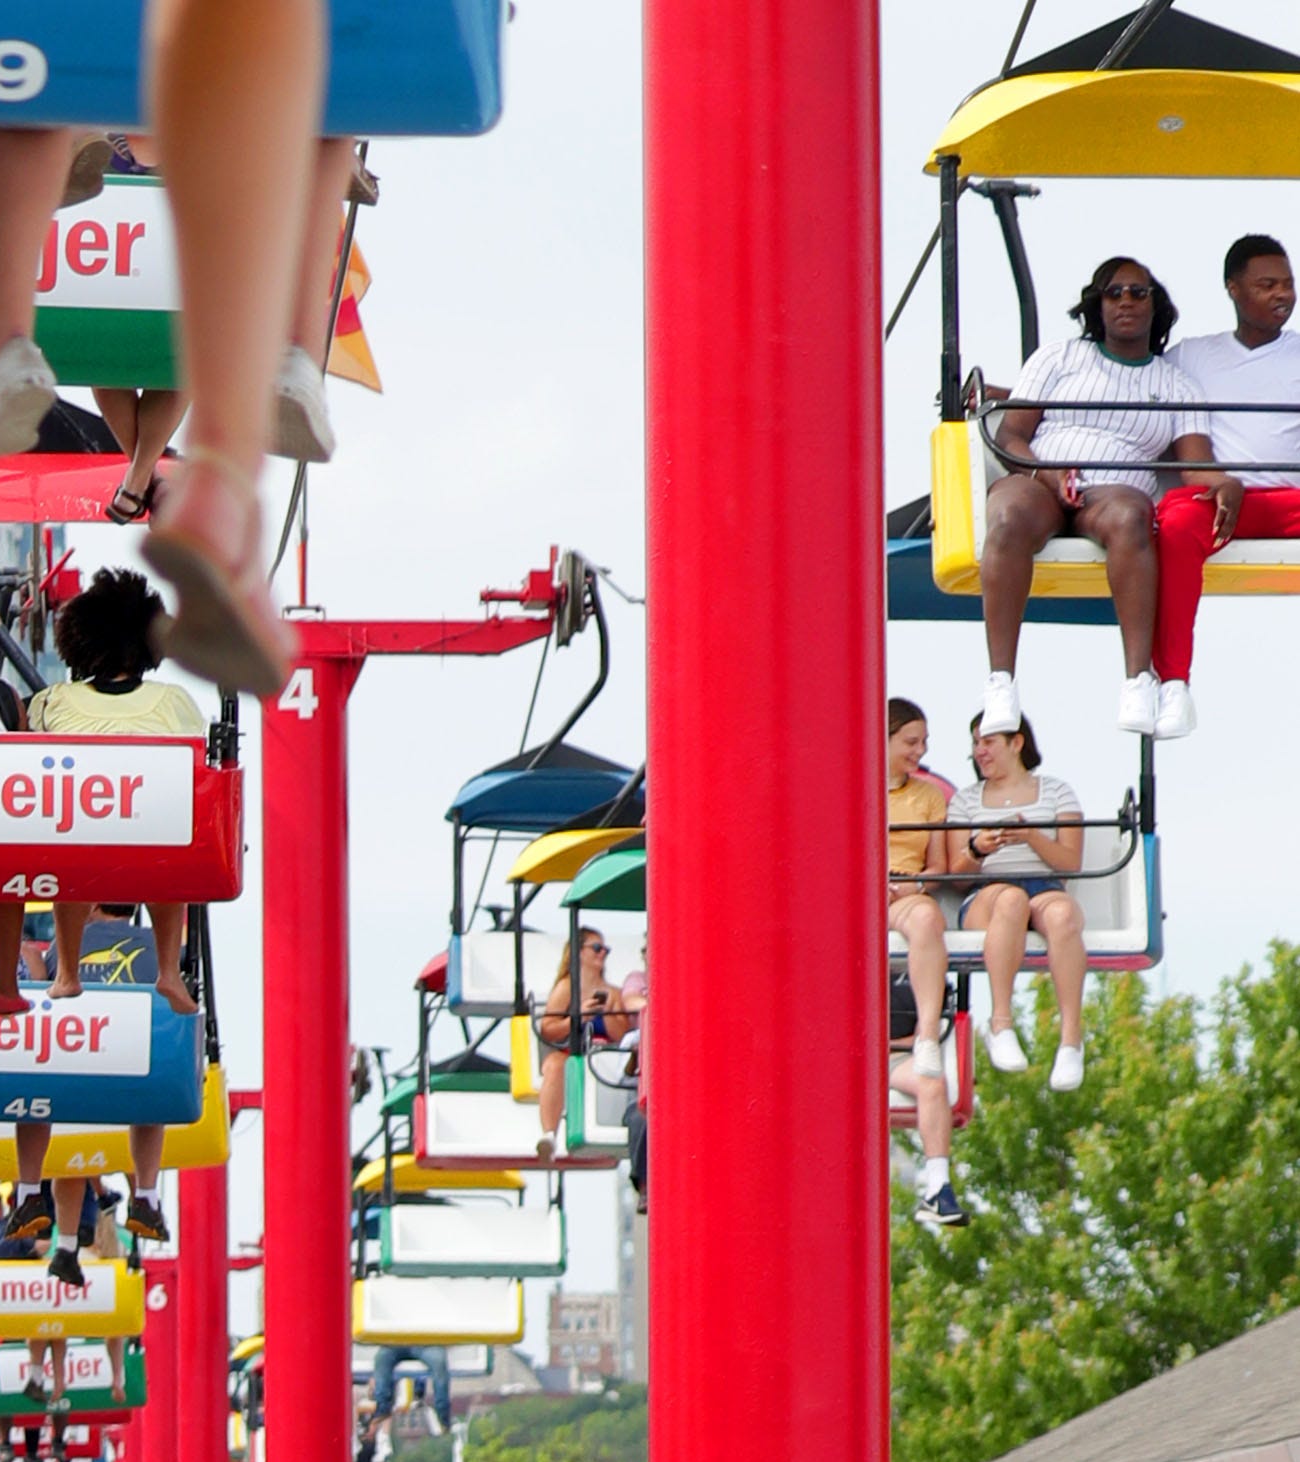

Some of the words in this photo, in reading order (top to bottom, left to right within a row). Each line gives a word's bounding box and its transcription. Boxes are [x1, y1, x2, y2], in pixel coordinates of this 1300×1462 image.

[279, 668, 319, 719] 4
[2, 874, 60, 898] 46
[3, 1098, 52, 1118] 45
[67, 1152, 108, 1169] 44
[1, 1278, 93, 1308] meijer
[147, 1283, 169, 1311] 6
[37, 1322, 64, 1335] 40
